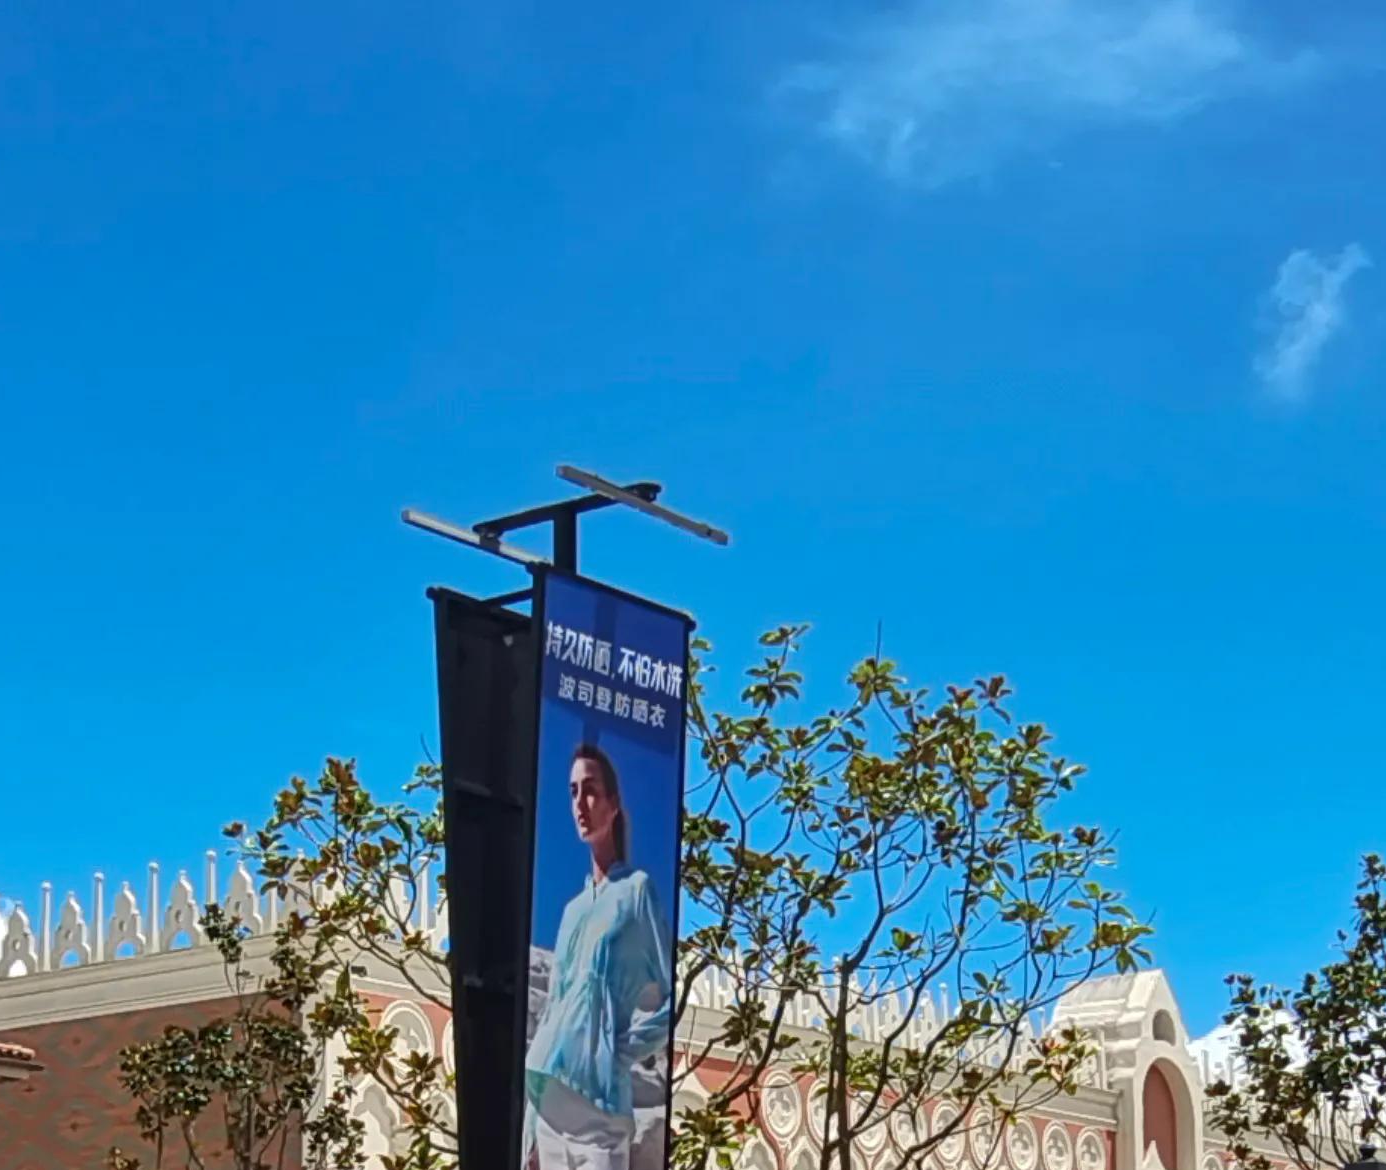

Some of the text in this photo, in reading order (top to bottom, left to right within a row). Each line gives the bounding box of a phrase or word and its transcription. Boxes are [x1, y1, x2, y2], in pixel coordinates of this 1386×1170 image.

[558, 673, 666, 727] 波司登防晒衣
